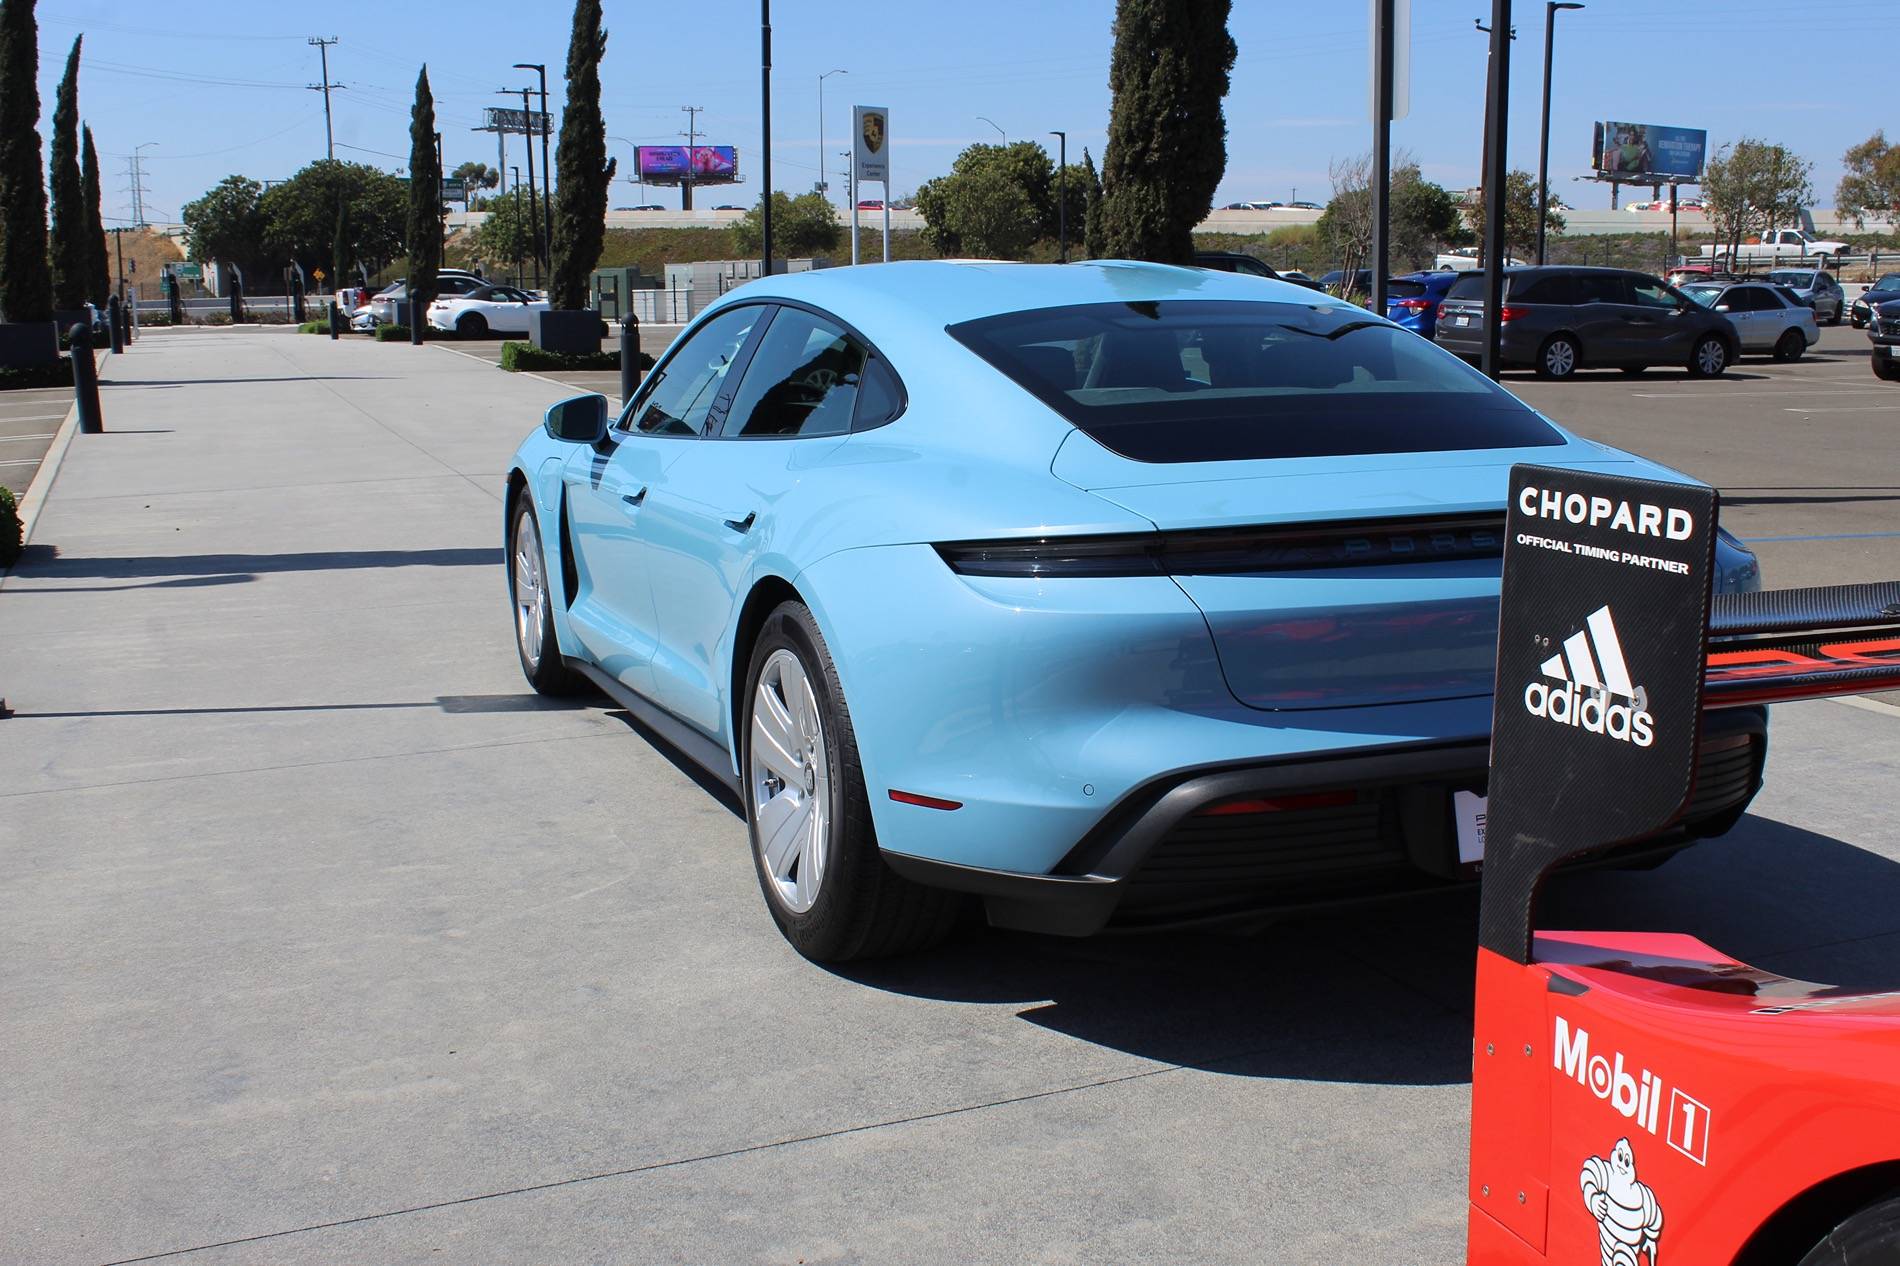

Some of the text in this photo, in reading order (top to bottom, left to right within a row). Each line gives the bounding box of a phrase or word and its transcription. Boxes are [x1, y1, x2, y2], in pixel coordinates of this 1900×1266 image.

[1519, 486, 1693, 541] CHOPARD
[1343, 531, 1496, 555] PORS
[1516, 533, 1689, 575] OFFICIAL TIMING PARTNER
[1524, 680, 1654, 747] adidas
[1553, 1015, 1696, 1151] Mobil 1
